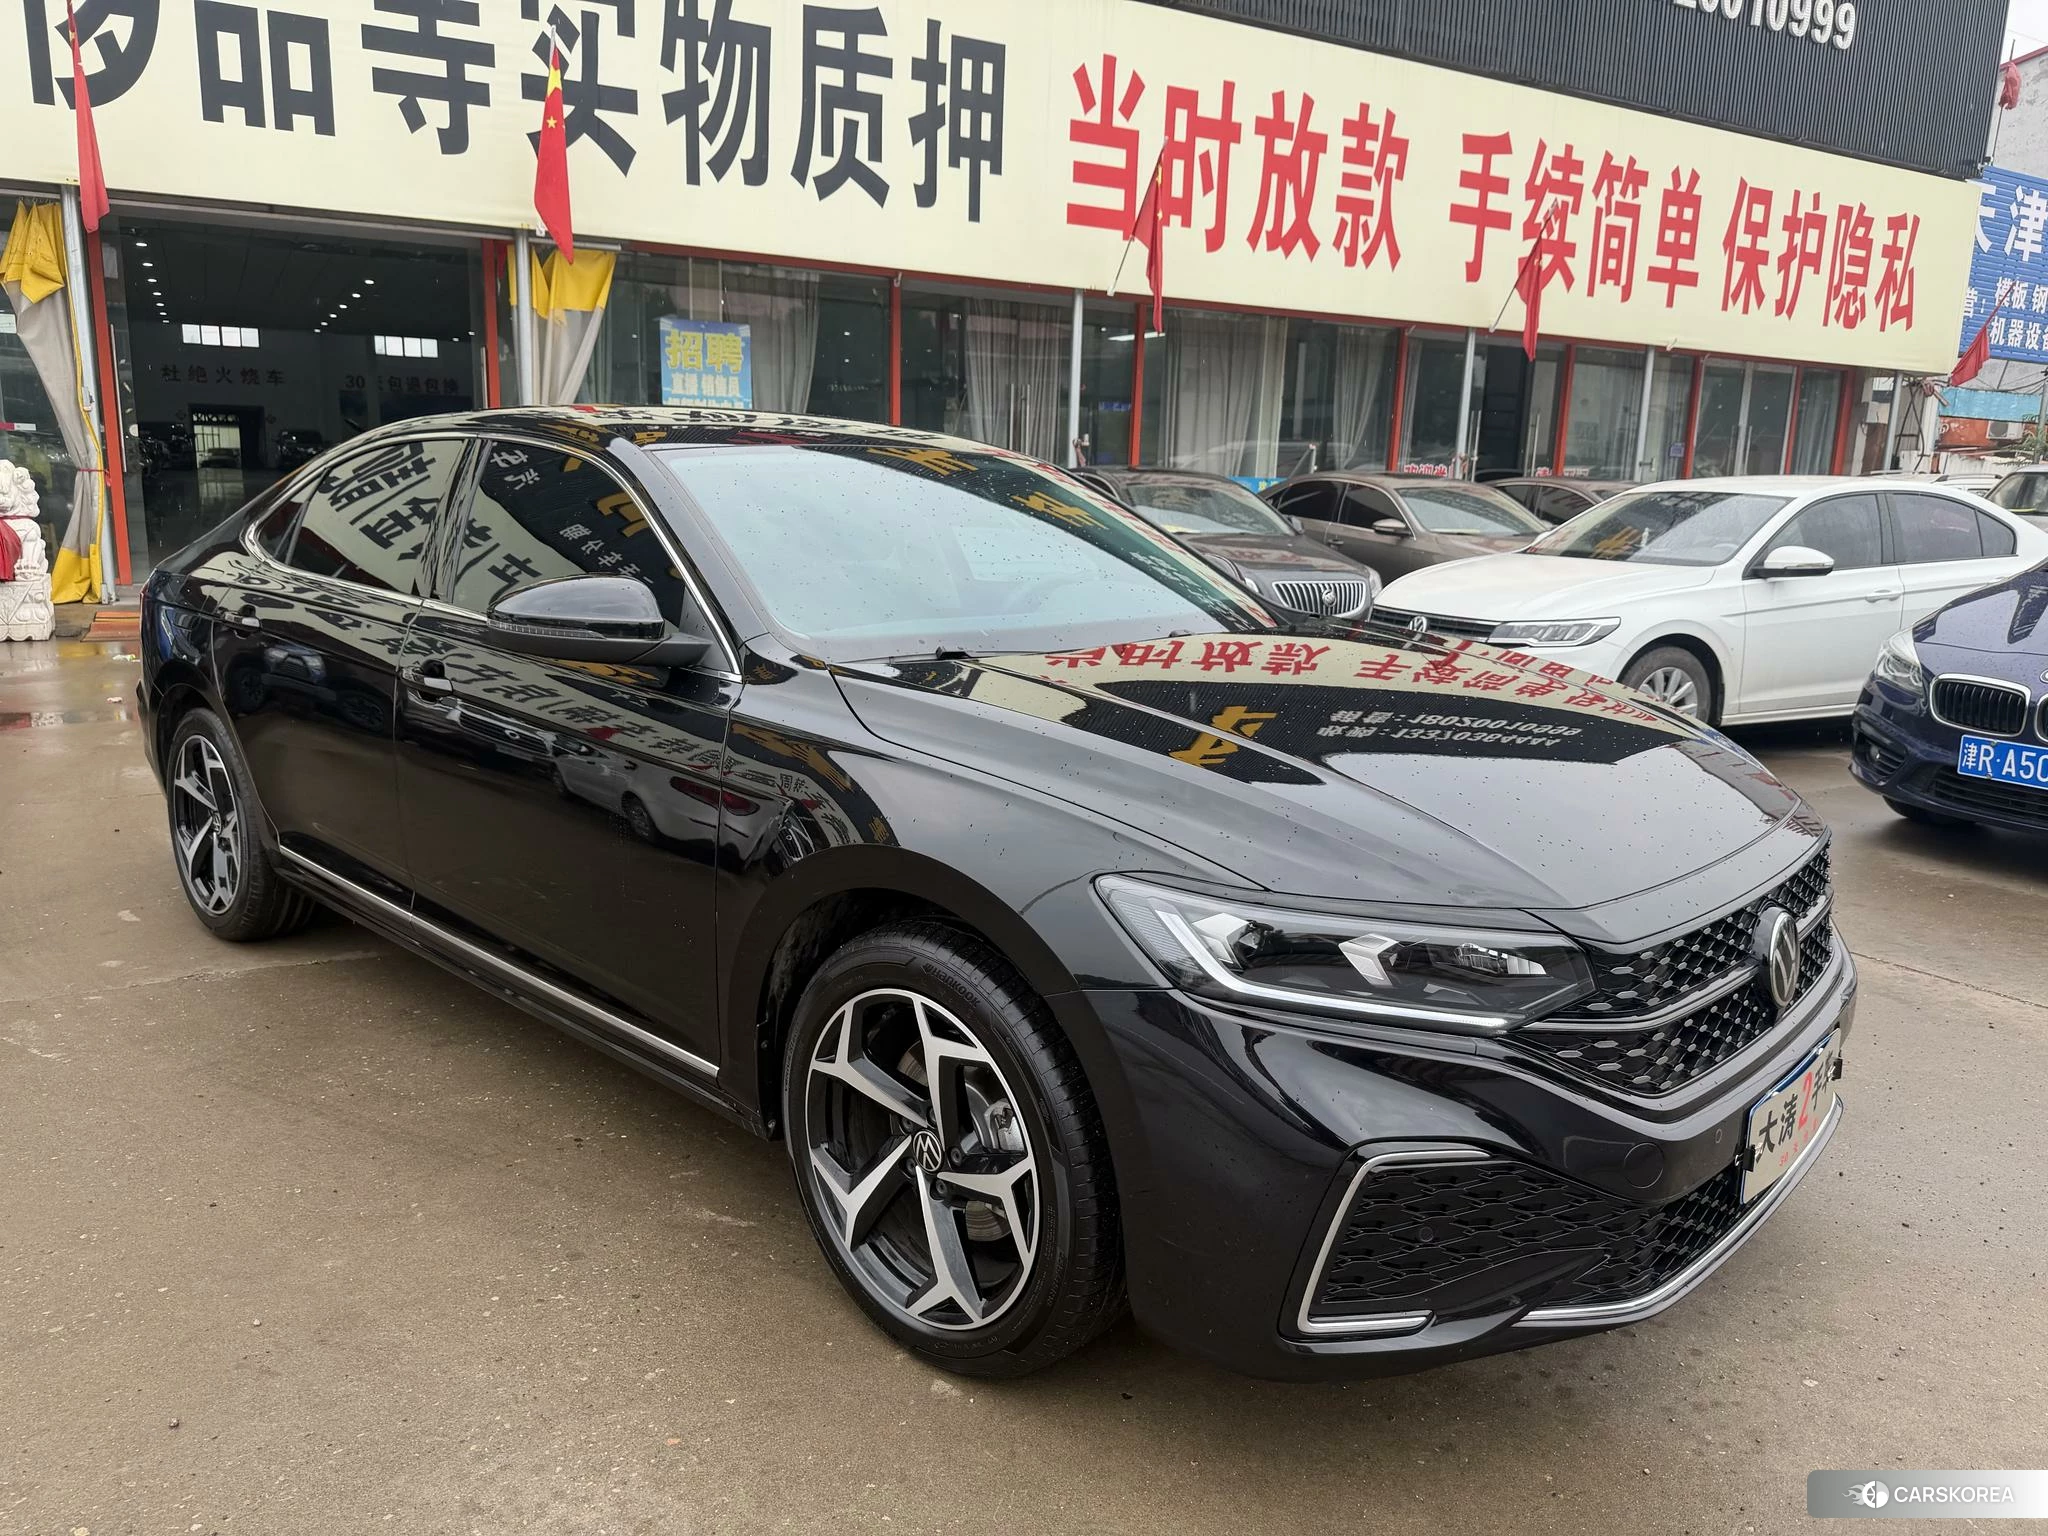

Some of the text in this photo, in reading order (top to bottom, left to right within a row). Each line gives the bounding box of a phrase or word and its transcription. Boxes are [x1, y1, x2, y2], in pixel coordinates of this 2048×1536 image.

[1672, 0, 1857, 50] 10999
[1066, 53, 1410, 272] 当时放款
[1449, 131, 1703, 309] 手续简单
[1721, 176, 1922, 333] 保护隐私
[665, 328, 743, 373] 招聘
